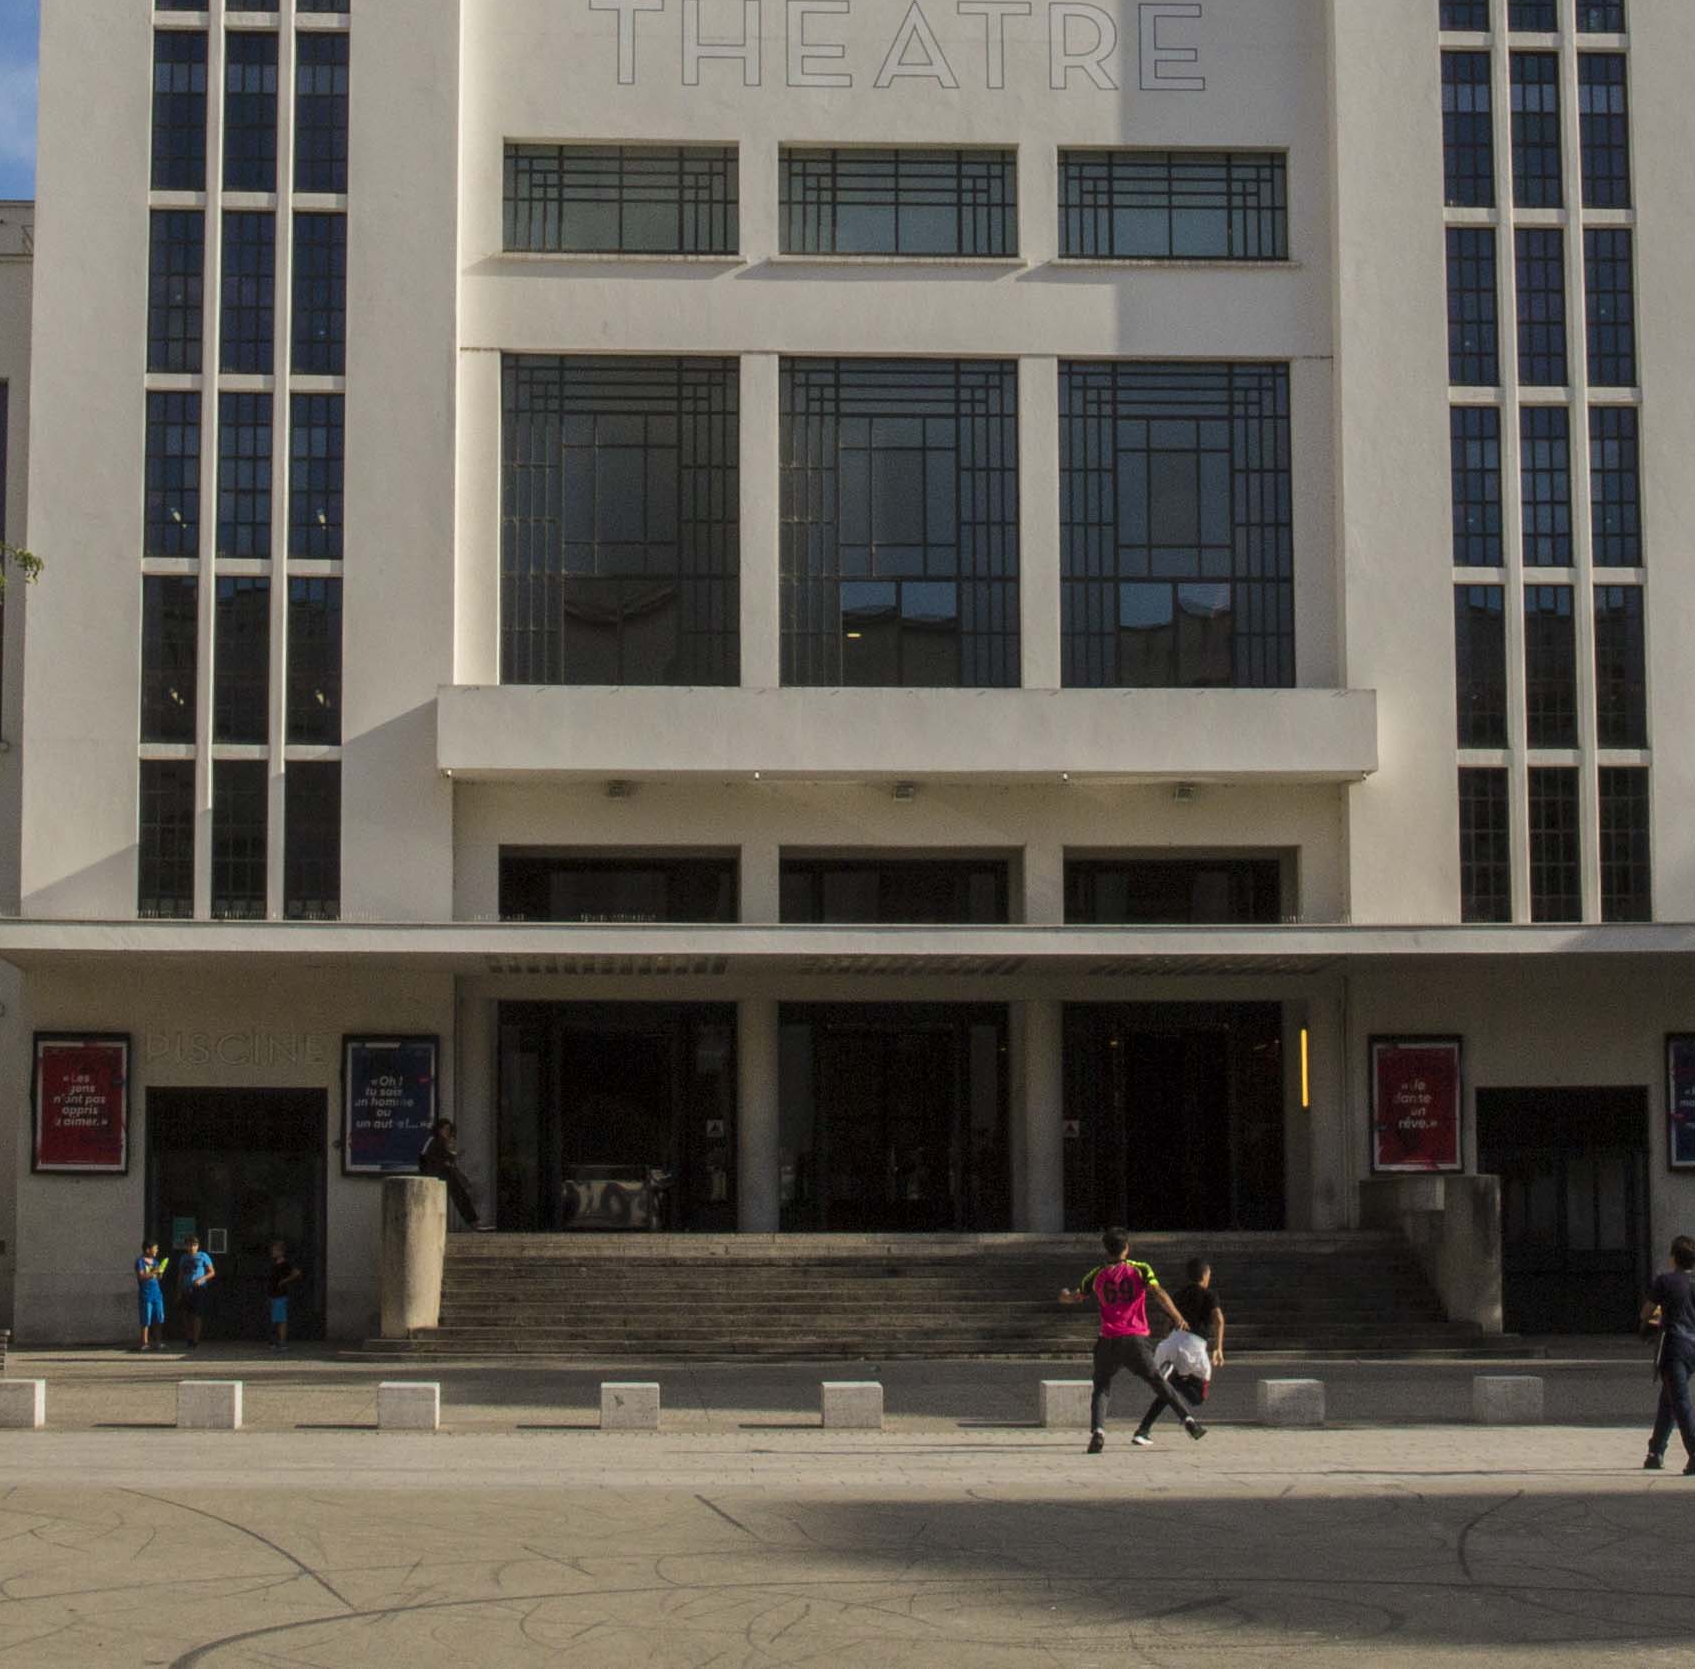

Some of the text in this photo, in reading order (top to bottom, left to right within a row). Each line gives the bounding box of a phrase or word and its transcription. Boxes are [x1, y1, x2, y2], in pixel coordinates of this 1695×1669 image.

[146, 1033, 328, 1066] PISCINE
[365, 1086, 377, 1097] tu
[84, 1096, 106, 1107] pas
[61, 1105, 98, 1117] appris
[376, 1109, 392, 1117] ou
[1410, 1107, 1426, 1117] un
[356, 1120, 371, 1129] un
